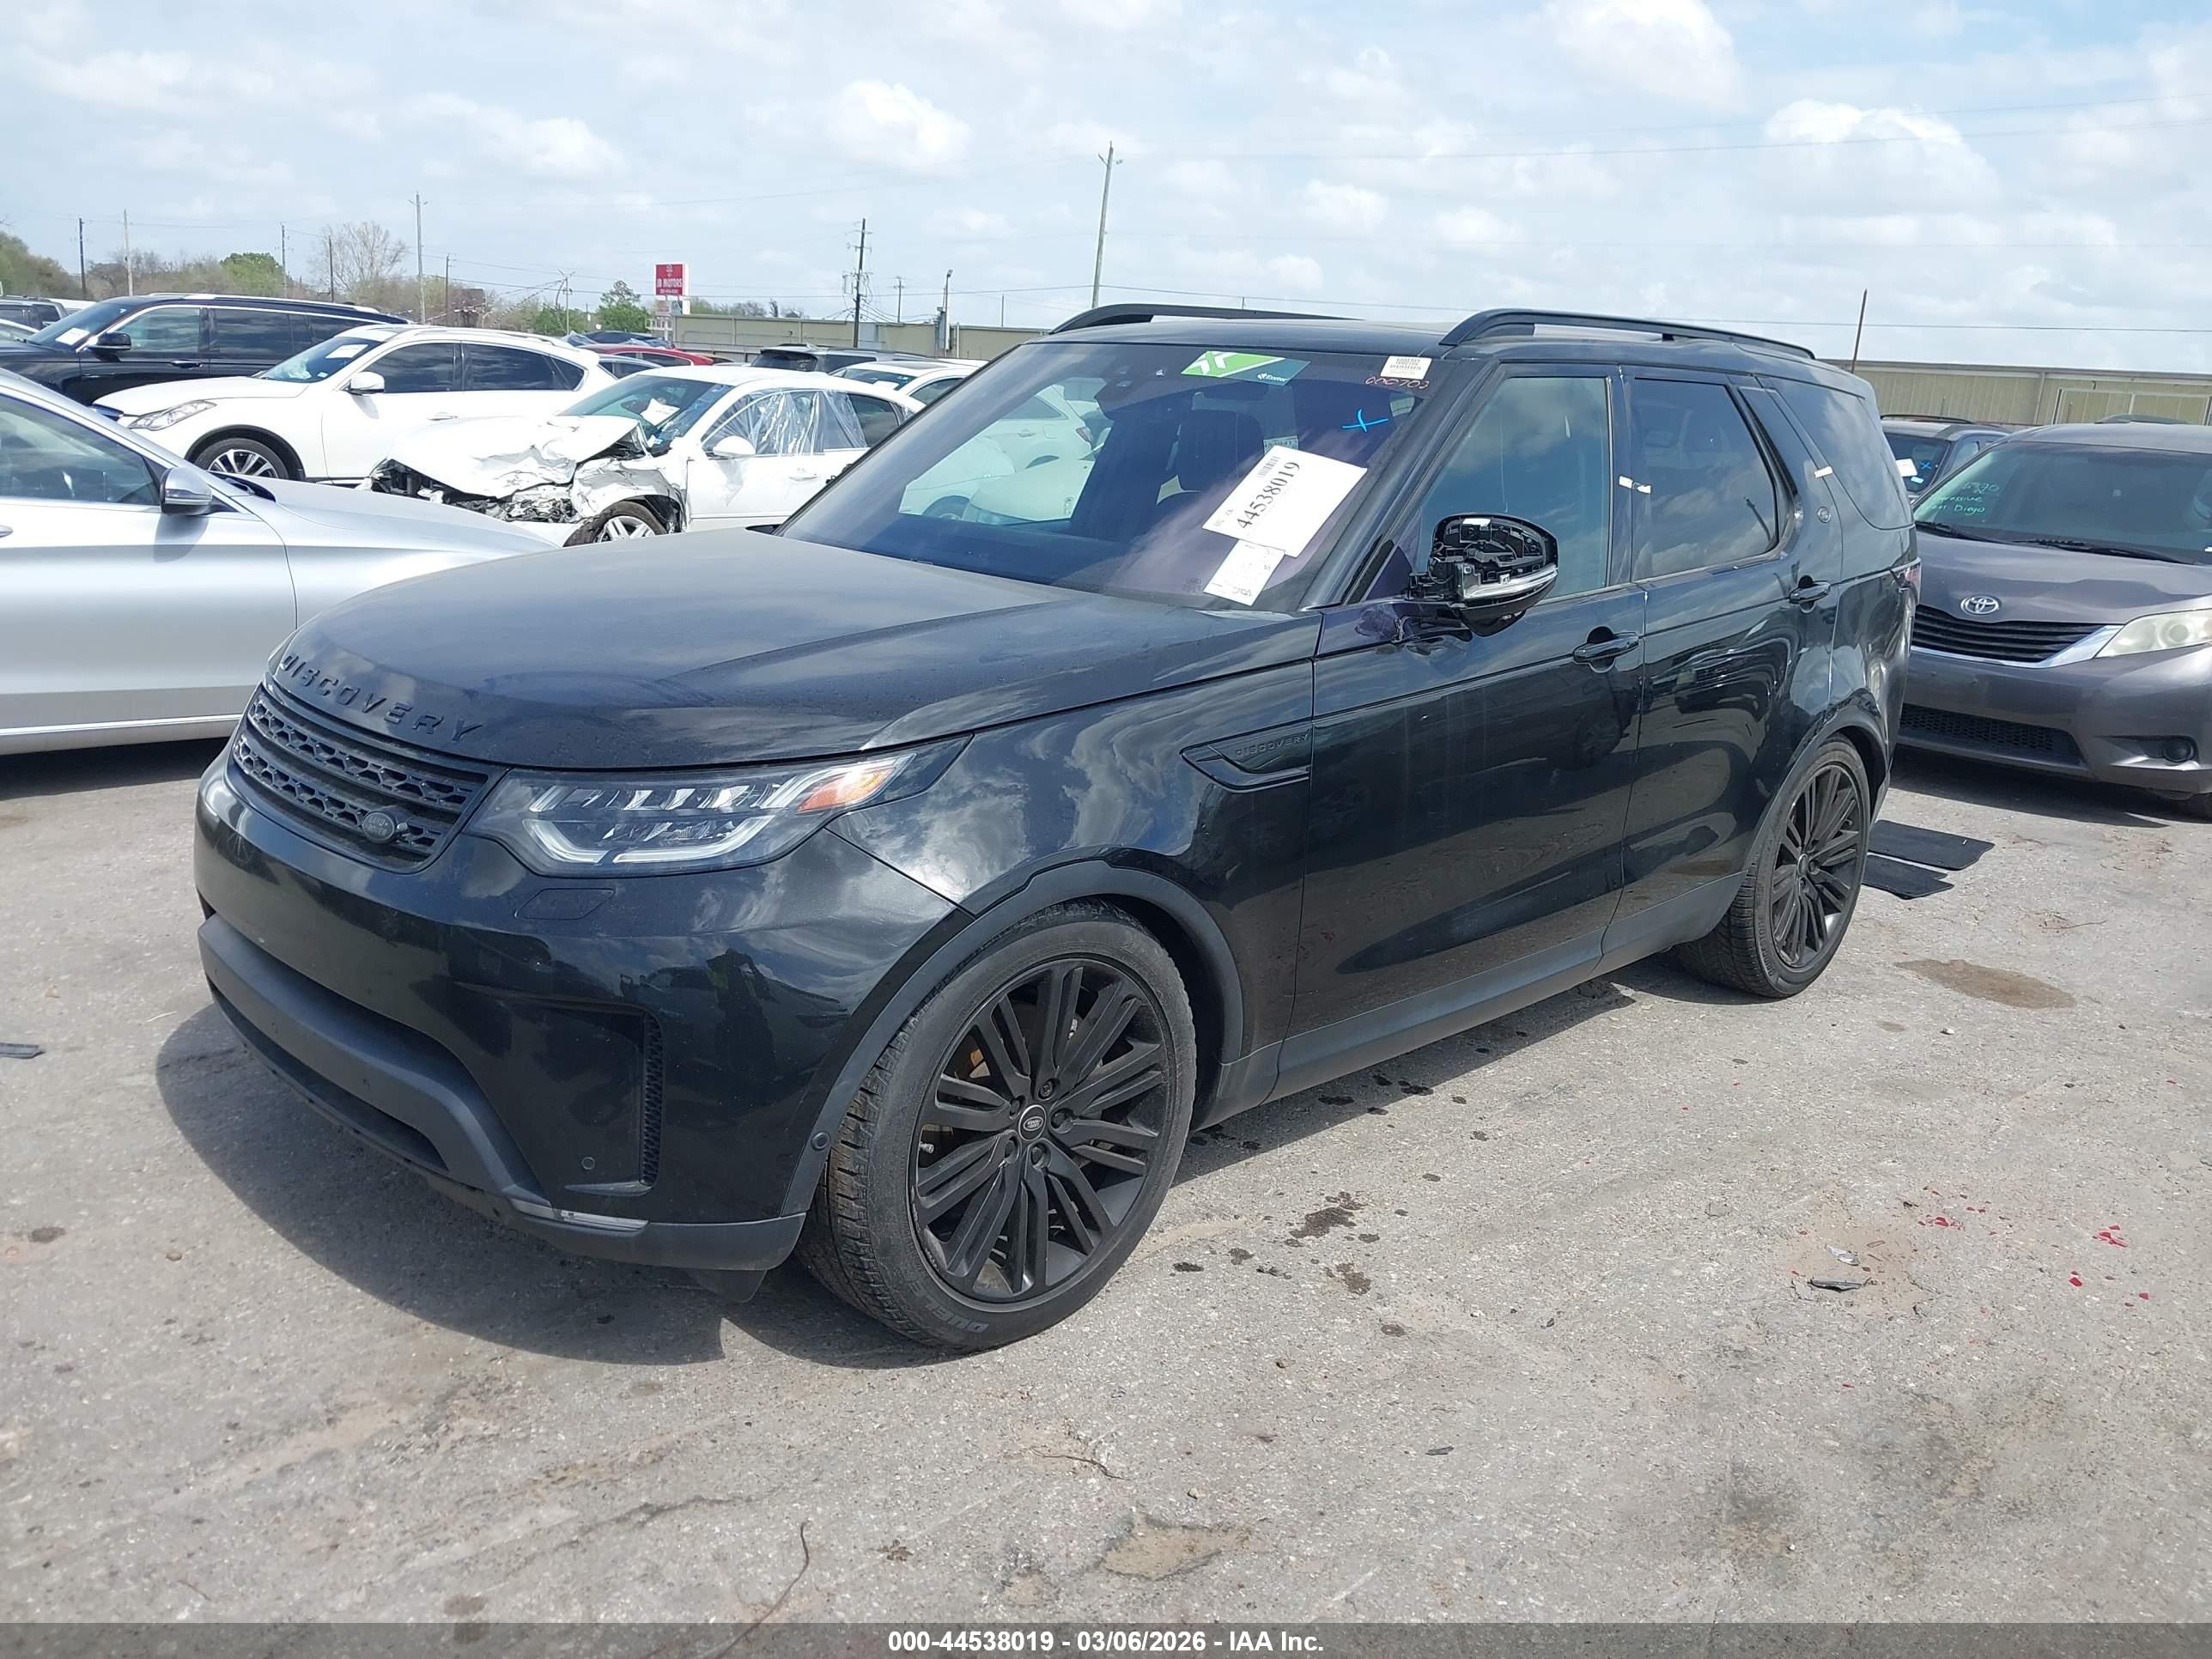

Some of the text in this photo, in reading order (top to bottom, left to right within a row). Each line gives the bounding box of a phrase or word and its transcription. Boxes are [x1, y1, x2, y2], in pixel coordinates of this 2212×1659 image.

[1237, 461, 1300, 529] 44538019
[1954, 504, 1985, 515] Diego
[281, 654, 483, 741] DISCOVERY
[1235, 733, 1309, 757] DISCOVERY
